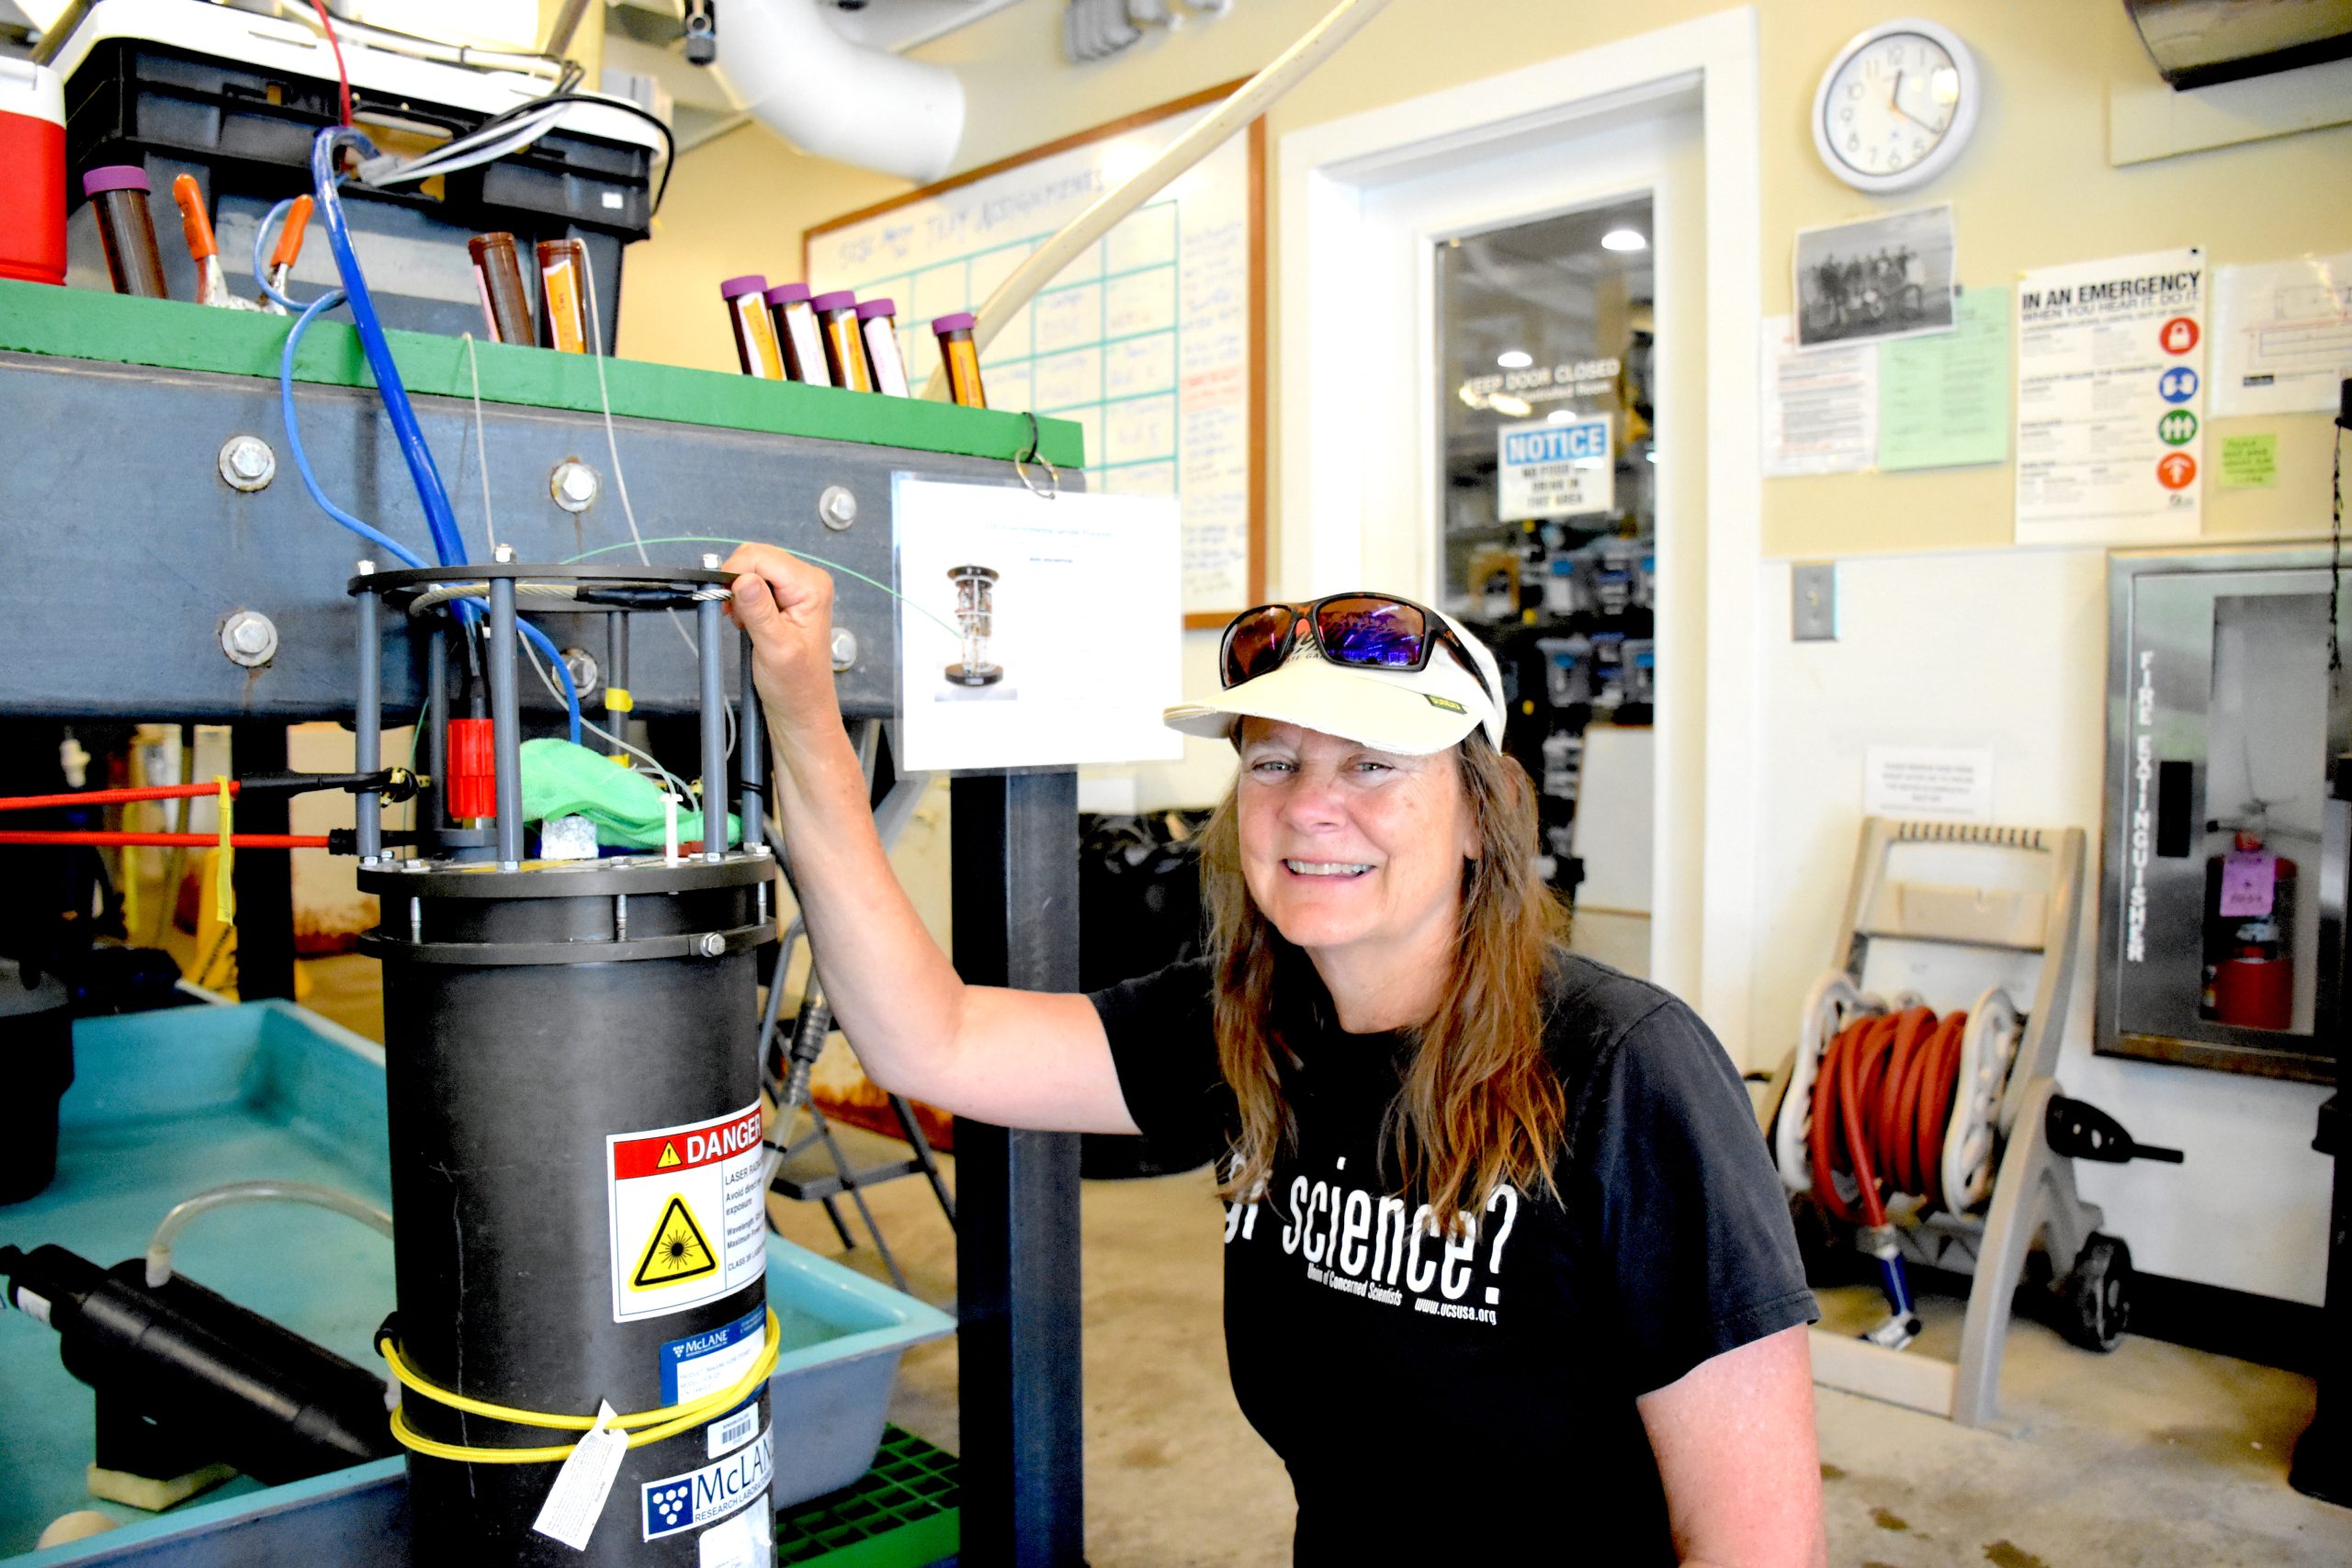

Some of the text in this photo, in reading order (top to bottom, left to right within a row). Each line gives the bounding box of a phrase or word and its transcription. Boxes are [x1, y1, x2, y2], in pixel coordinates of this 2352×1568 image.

[1887, 44, 1905, 66] 12
[1865, 58, 1880, 79] 11
[1848, 80, 1866, 101] 10
[1839, 106, 1854, 126] 9
[1847, 132, 1860, 152] 8
[1869, 146, 1880, 165] 7
[1888, 147, 1902, 169] 6
[2023, 270, 2201, 310] IN AN EMERGENCY
[1505, 367, 1553, 390] DOOR
[1554, 356, 1622, 384] CLOSED
[1508, 425, 1604, 464] NOTICE
[2126, 650, 2155, 963] FIRE EXTINGUISHER
[686, 1112, 761, 1164] DANGER
[725, 1167, 748, 1186] LASER
[726, 1187, 744, 1202] Avoid
[1283, 1156, 1518, 1305] science?
[728, 1257, 745, 1271] CLASS
[1307, 1262, 1323, 1283] Union
[1329, 1270, 1368, 1297] Concerned
[1368, 1280, 1403, 1306] Scientists
[1415, 1297, 1498, 1325] www.ucsusa.org
[695, 1438, 772, 1509] McLAN
[695, 1499, 739, 1523] RESEARCH
